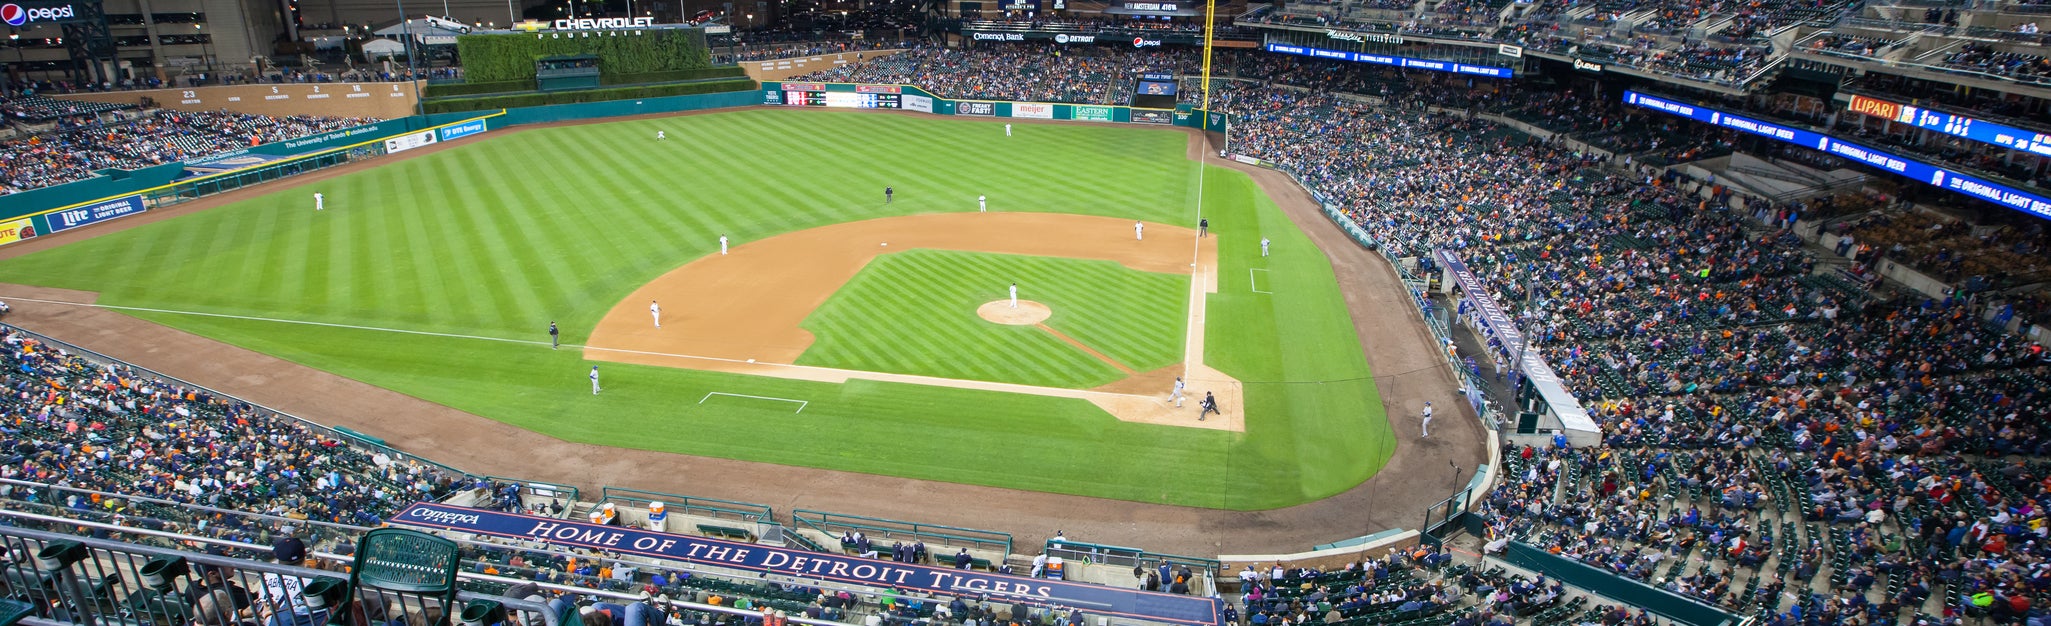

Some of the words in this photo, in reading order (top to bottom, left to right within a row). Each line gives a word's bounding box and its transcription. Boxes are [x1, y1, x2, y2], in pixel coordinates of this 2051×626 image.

[28, 5, 74, 22] pepsi
[555, 17, 654, 30] CHEVROLET
[538, 30, 641, 39] FOUNTAIN
[1366, 34, 1383, 42] TIGER
[1582, 62, 1602, 72] LEXUS
[272, 86, 278, 94] 5
[1020, 104, 1044, 113] meijer
[1645, 98, 1665, 109] ORIGINAL
[1666, 102, 1680, 112] LIGHT
[1680, 106, 1693, 116] BEER
[1856, 98, 1894, 118] LIPARI
[296, 136, 323, 147] University
[350, 126, 378, 135] utoledo.edu
[464, 124, 482, 133] Energy
[1731, 118, 1758, 131] ORIGINAL
[1758, 125, 1777, 136] LIGHT
[1776, 129, 1794, 140] BEER
[1840, 145, 1868, 161] ORIGINAL
[1868, 153, 1888, 167] LIGHT
[1887, 158, 1906, 172] BEER
[1950, 177, 1963, 189] THE
[1962, 181, 2002, 200] ORIGINAL
[2003, 192, 2032, 209] LIGHT
[60, 209, 89, 227] Lite
[100, 201, 131, 211] ORIGINAL
[95, 210, 114, 219] LIGHT
[115, 206, 133, 214] BEER
[1457, 270, 1481, 290] TIGERS
[1473, 292, 1506, 322] DETROIT
[1497, 324, 1520, 338] THE
[424, 516, 458, 524] PARK
[526, 522, 625, 546] HOME
[633, 537, 677, 553] OF
[687, 542, 750, 563] THE
[761, 551, 916, 582] DETROIT
[930, 570, 1051, 600] TIGERS
